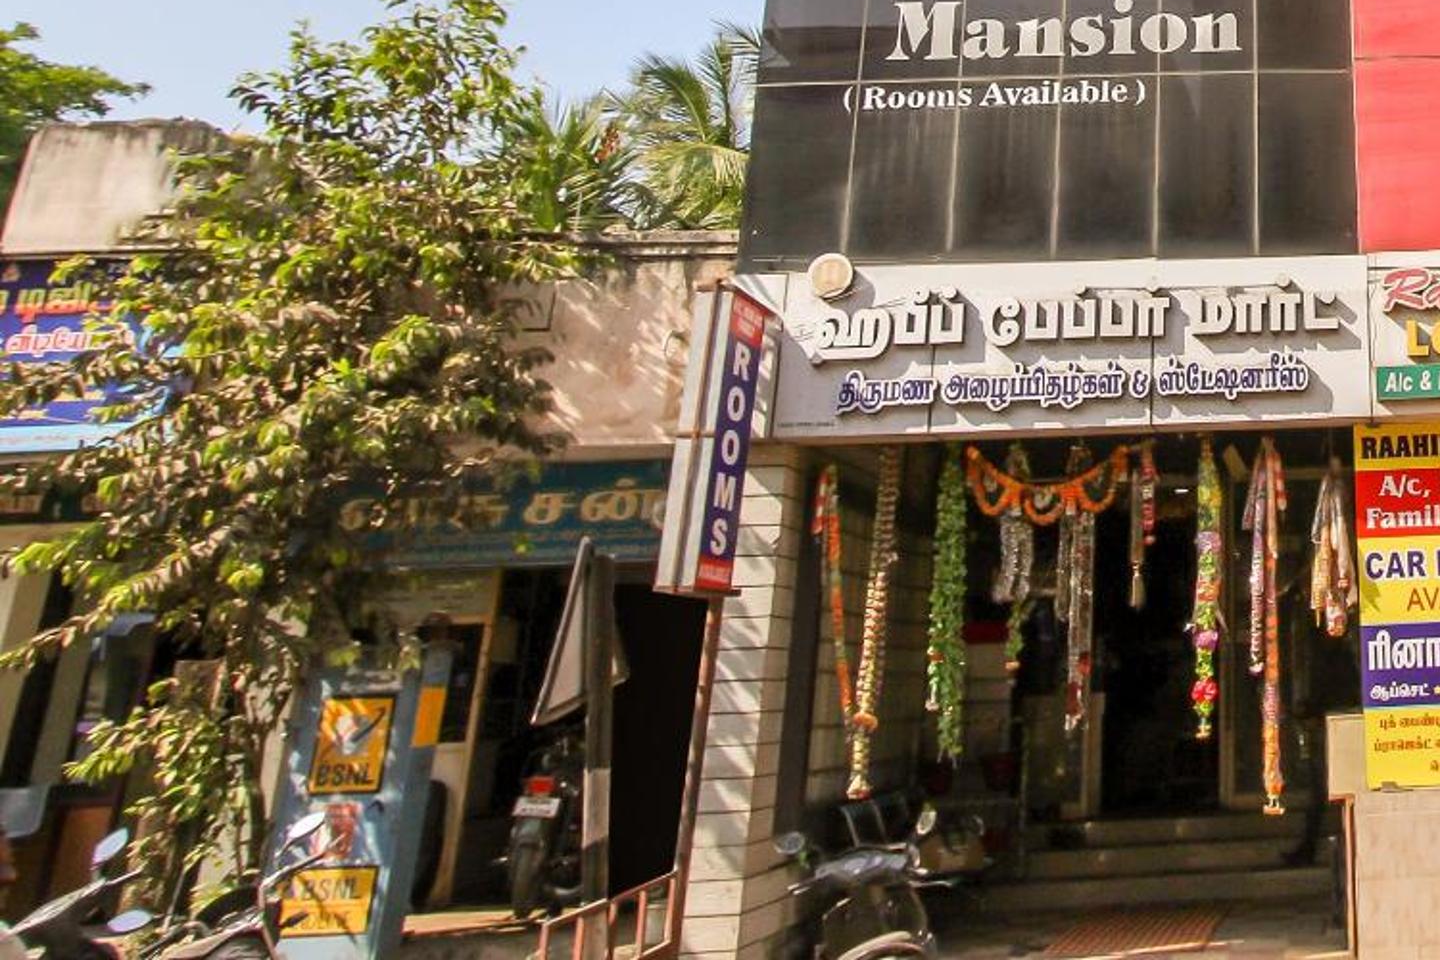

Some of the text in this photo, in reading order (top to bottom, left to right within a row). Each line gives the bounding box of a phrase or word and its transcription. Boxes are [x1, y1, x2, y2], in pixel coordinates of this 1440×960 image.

[836, 370, 936, 416] திருமண
[942, 360, 1125, 411] அழைப்பிதழ்கள்
[1132, 369, 1150, 396] &
[1420, 371, 1431, 390] &
[710, 341, 752, 557] ROOMS
[1379, 474, 1431, 498] A/c,
[1366, 551, 1426, 580] CAR
[315, 760, 374, 787] BSNL
